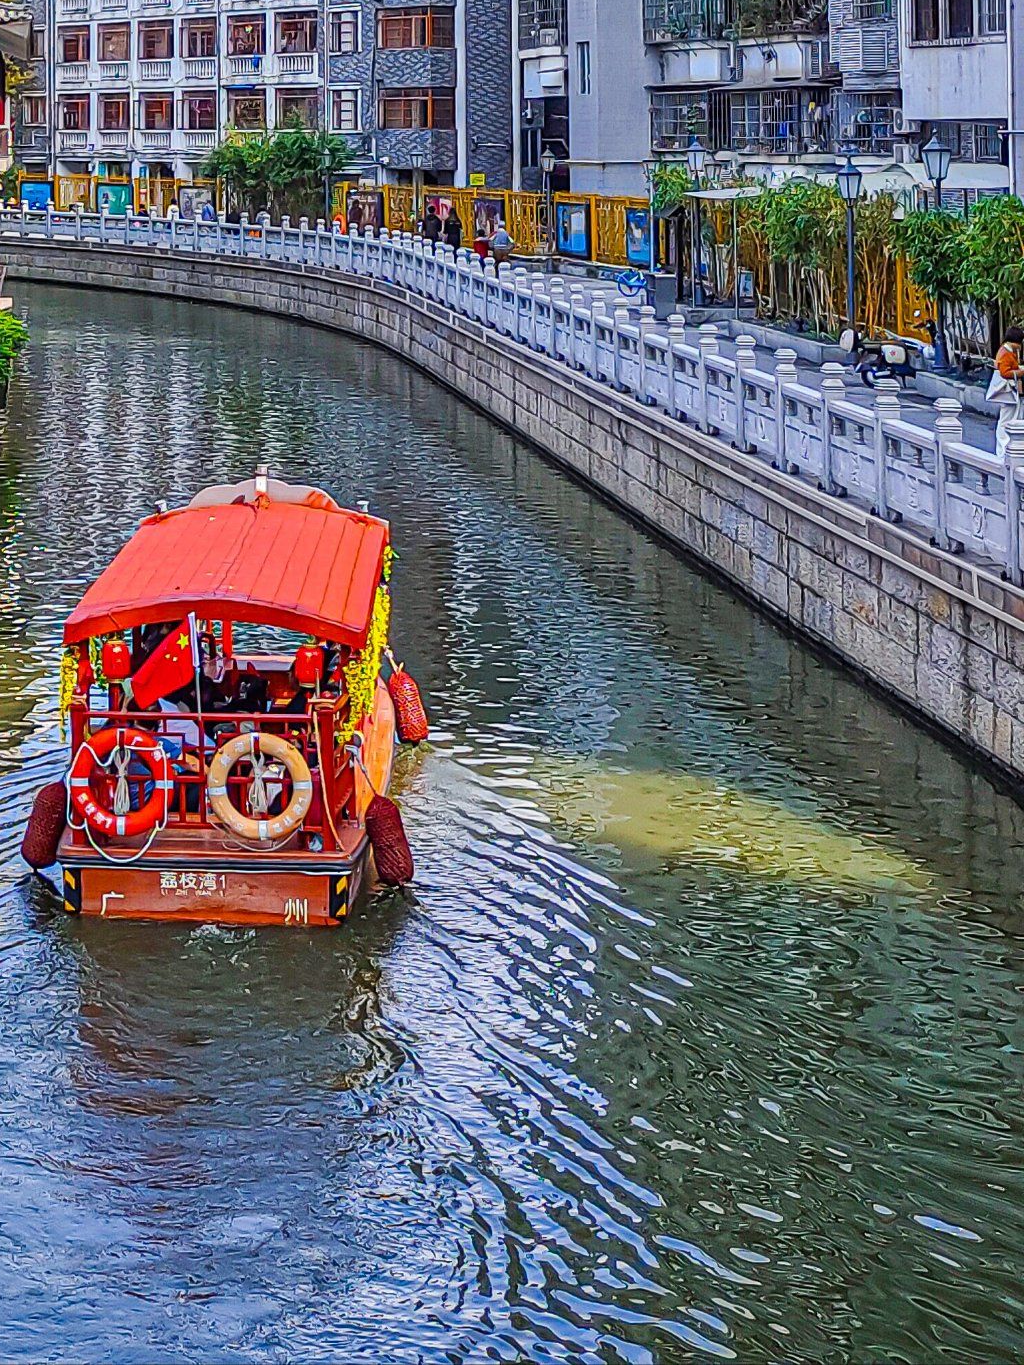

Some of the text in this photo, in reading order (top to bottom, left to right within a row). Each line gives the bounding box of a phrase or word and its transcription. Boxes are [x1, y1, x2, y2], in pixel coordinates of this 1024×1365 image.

[160, 872, 226, 890] 荔枝湾1
[100, 890, 308, 925] 广 州
